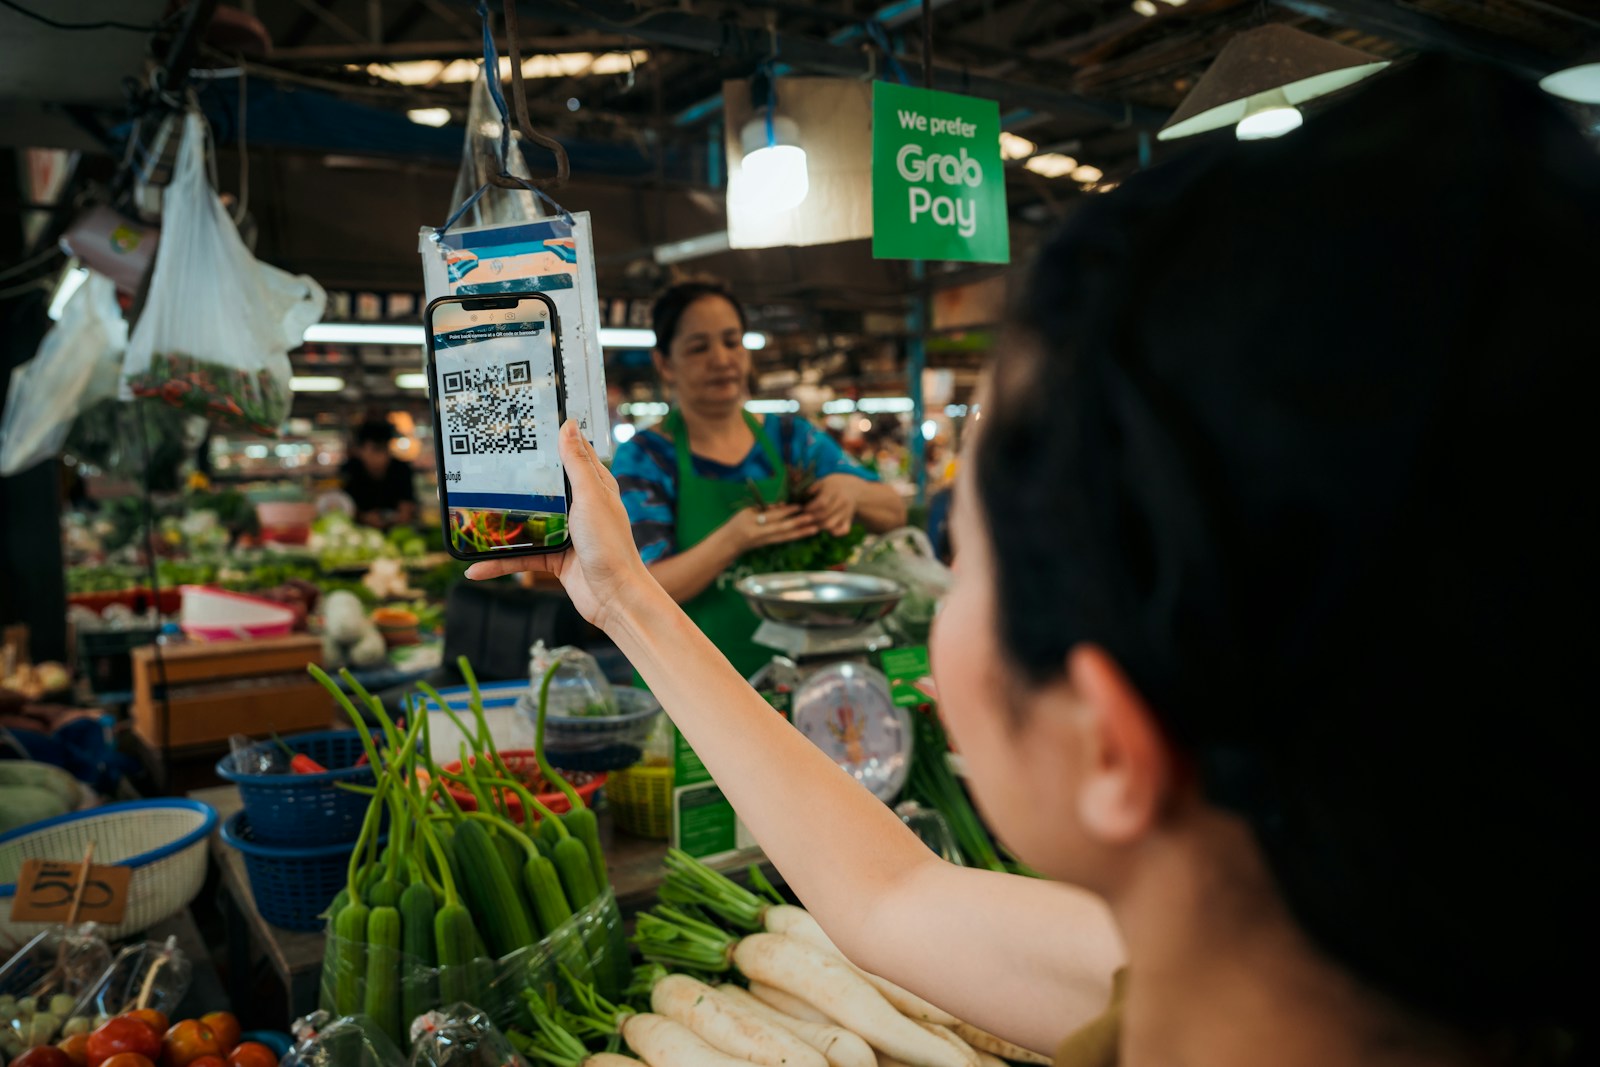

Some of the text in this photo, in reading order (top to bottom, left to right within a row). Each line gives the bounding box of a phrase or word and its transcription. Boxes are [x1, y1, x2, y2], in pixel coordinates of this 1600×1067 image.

[897, 109, 977, 138] We prefer
[896, 143, 983, 188] Grab
[908, 186, 977, 238] Pay
[30, 871, 114, 909] 50
